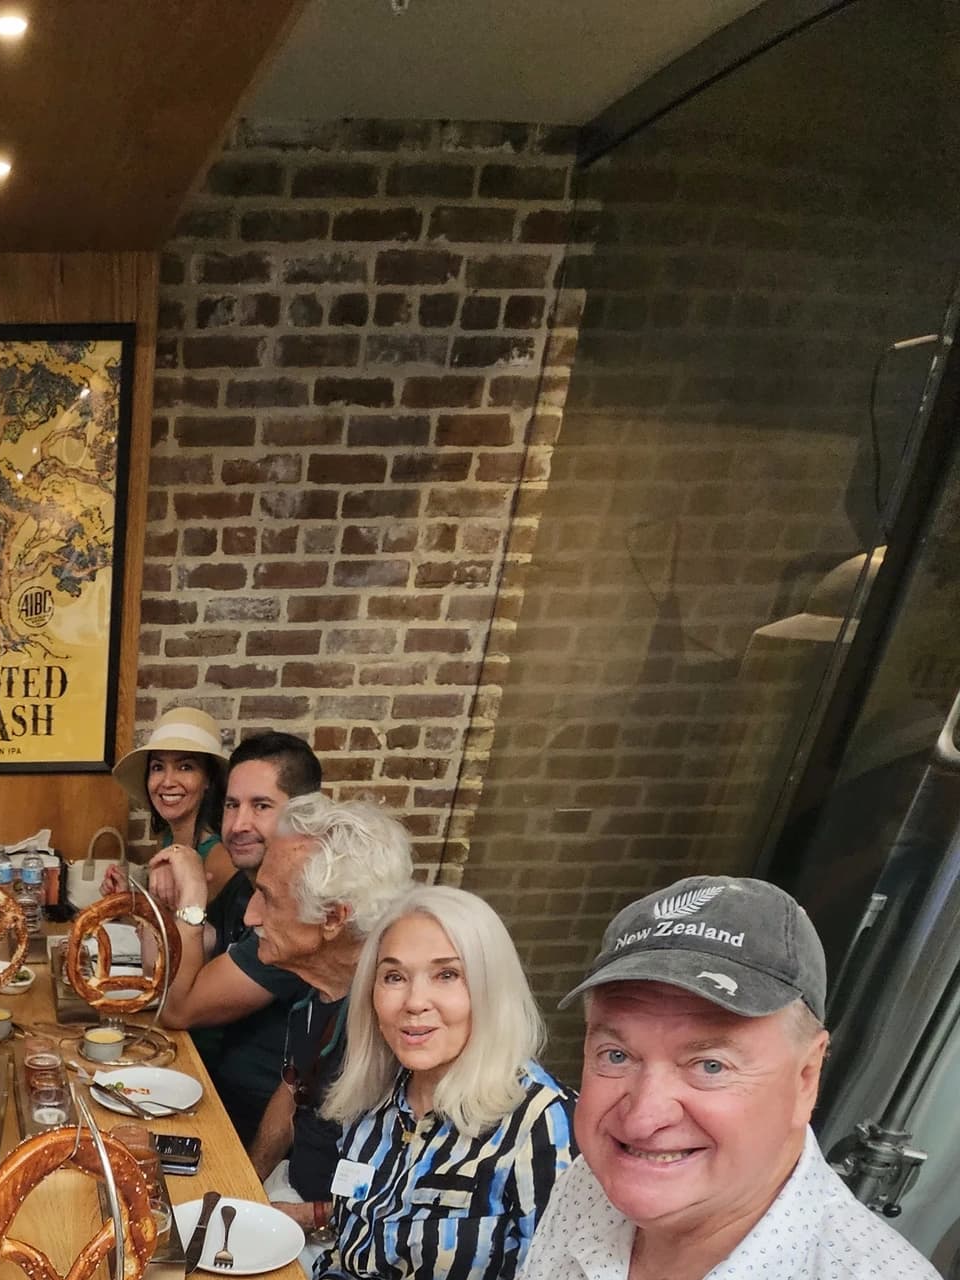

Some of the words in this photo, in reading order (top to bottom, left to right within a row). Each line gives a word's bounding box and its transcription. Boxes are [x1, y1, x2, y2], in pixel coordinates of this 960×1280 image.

[20, 590, 52, 617] AIBC
[615, 926, 651, 950] New
[653, 920, 745, 948] Zealand
